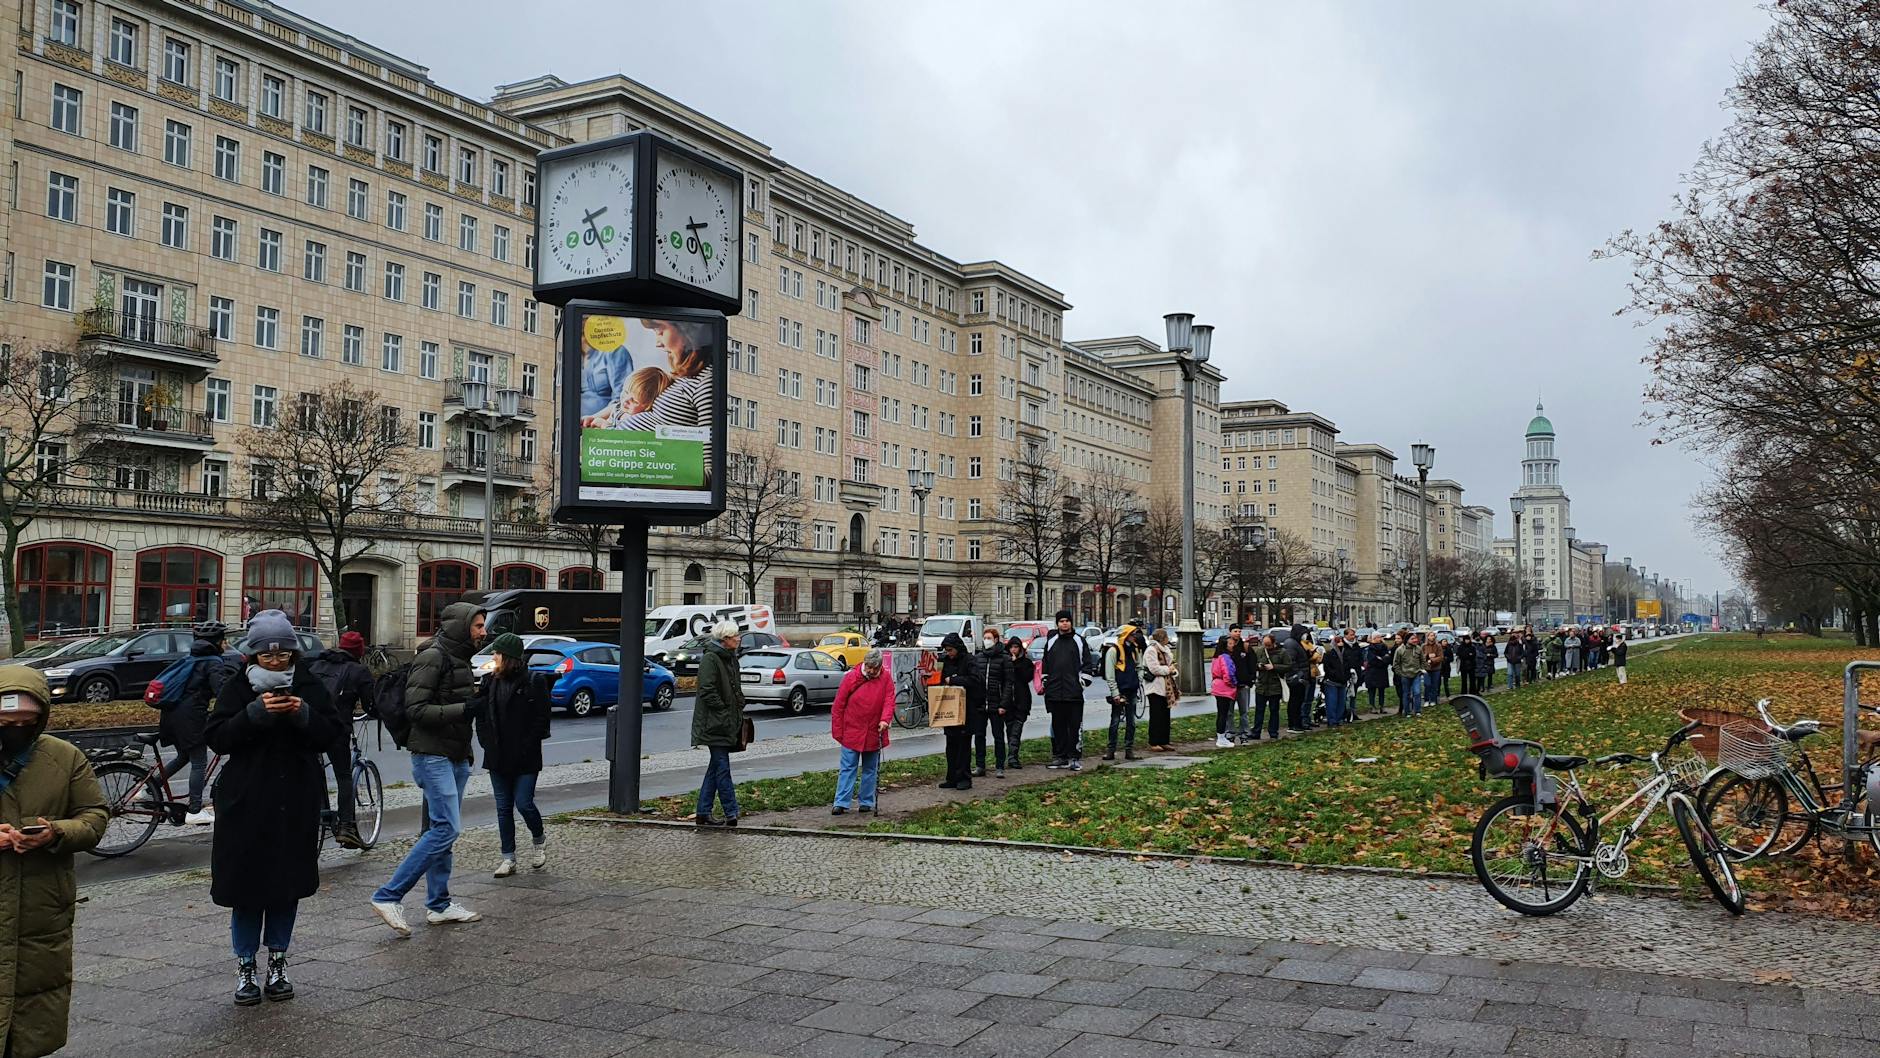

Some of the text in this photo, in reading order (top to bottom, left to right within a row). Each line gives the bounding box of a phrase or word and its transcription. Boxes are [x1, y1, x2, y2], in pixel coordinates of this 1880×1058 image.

[588, 446, 656, 458] Kommen Sie
[588, 457, 677, 471] der Grippe zuvor.
